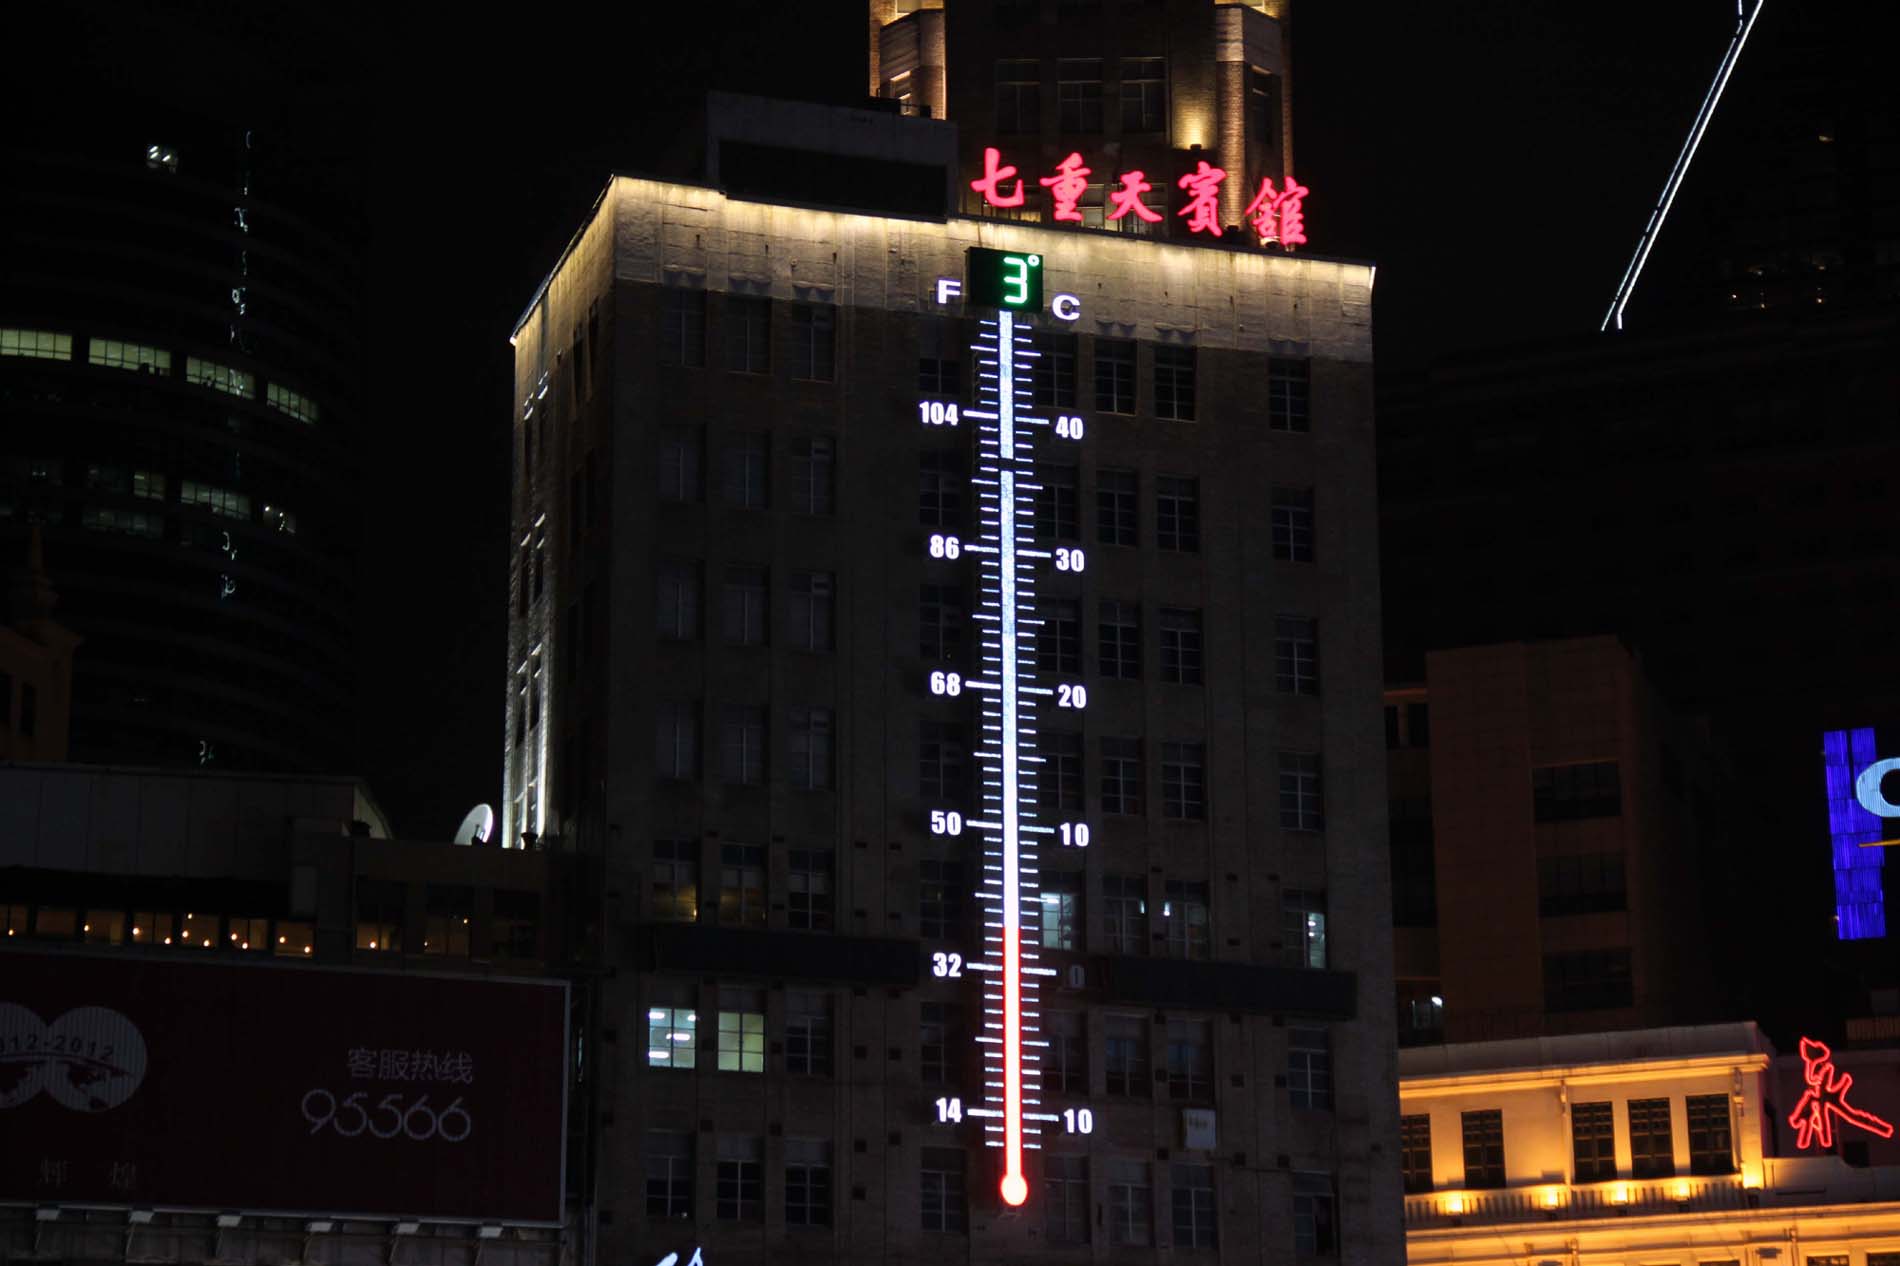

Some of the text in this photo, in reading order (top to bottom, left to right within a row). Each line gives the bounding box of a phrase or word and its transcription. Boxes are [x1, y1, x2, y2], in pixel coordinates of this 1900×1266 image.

[937, 279, 961, 304] F
[1052, 294, 1081, 320] C
[919, 401, 959, 426] 104
[1054, 415, 1084, 440] 40
[929, 534, 960, 560] 86
[1054, 547, 1085, 573] 30
[929, 670, 961, 697] 68
[1057, 683, 1087, 709] 20
[930, 810, 962, 836] 50
[1059, 822, 1090, 848] 10
[931, 952, 962, 978] 32
[346, 1046, 473, 1084] 客服热线
[301, 1088, 472, 1143] 95566
[935, 1098, 963, 1123] 14
[1063, 1108, 1093, 1134] 10
